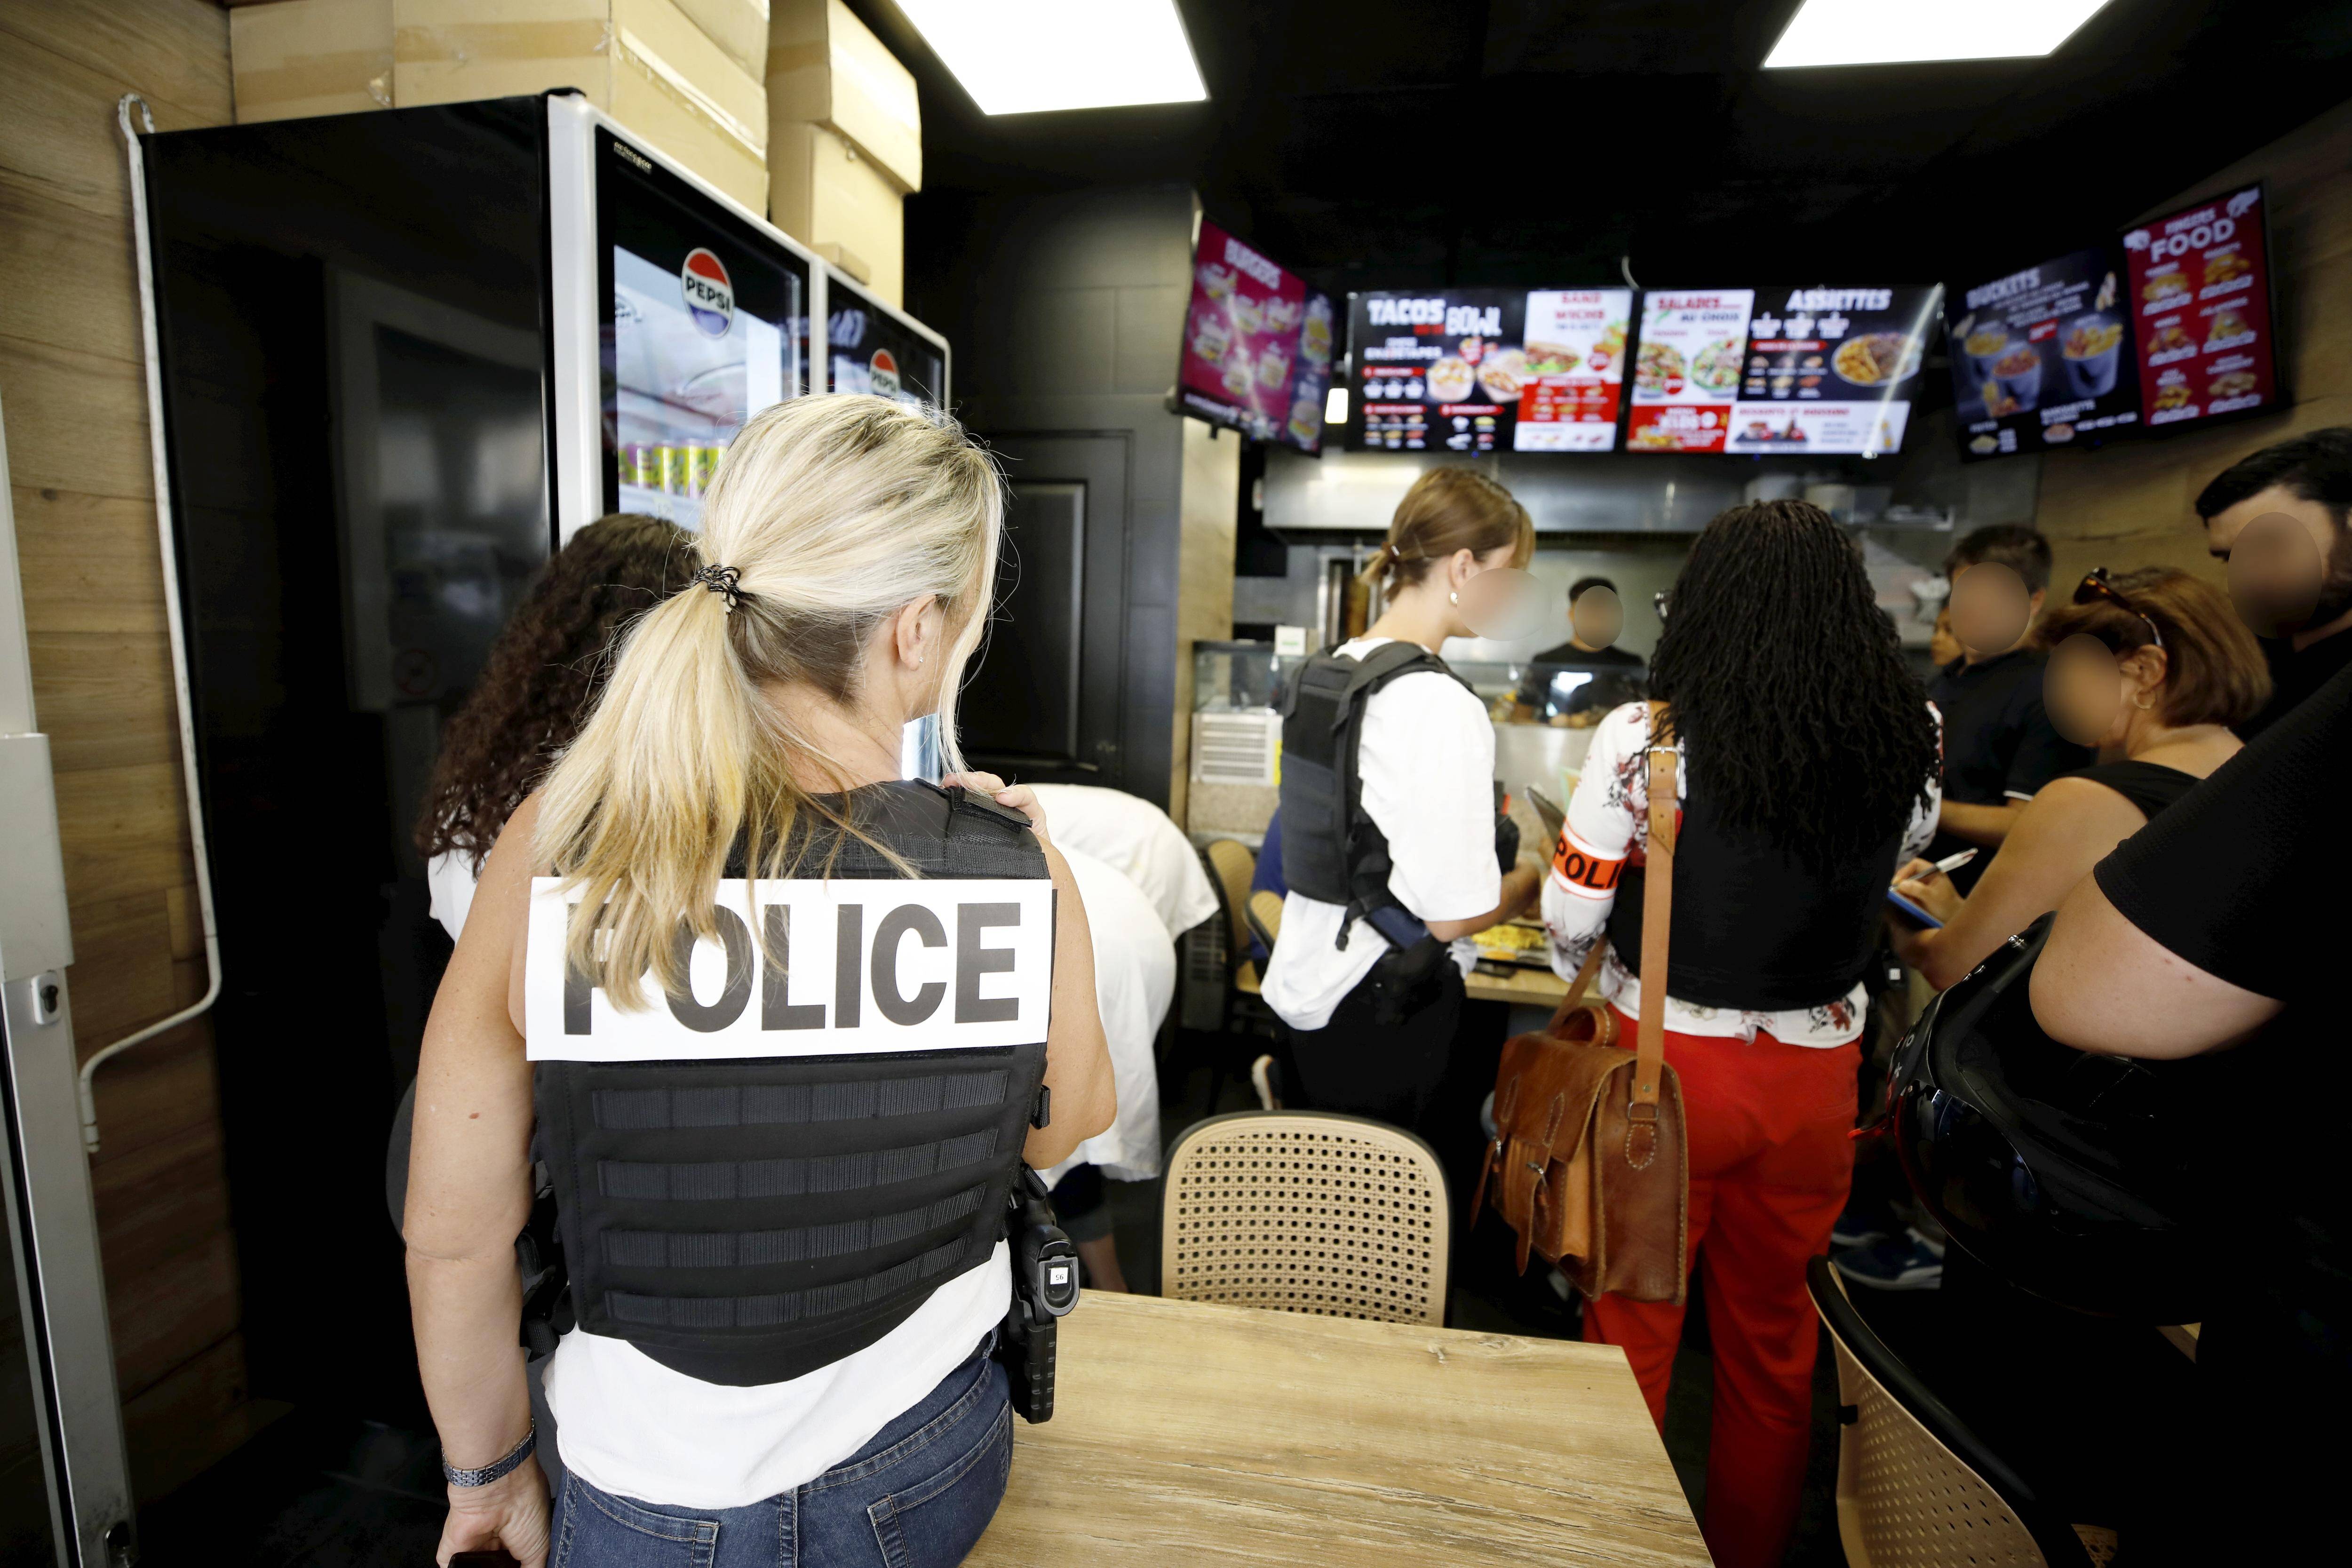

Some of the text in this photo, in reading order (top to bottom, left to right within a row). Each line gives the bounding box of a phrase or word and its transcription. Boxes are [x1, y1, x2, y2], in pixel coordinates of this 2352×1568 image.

[2151, 219, 2235, 263] FOOD
[1224, 238, 1281, 290] BURGERS
[686, 276, 730, 313] PEPSI
[1658, 297, 1720, 309] SALADES
[1785, 289, 1892, 311] ASSIETTES
[1367, 298, 1446, 326] TACOS
[1445, 306, 1502, 336] BOWL
